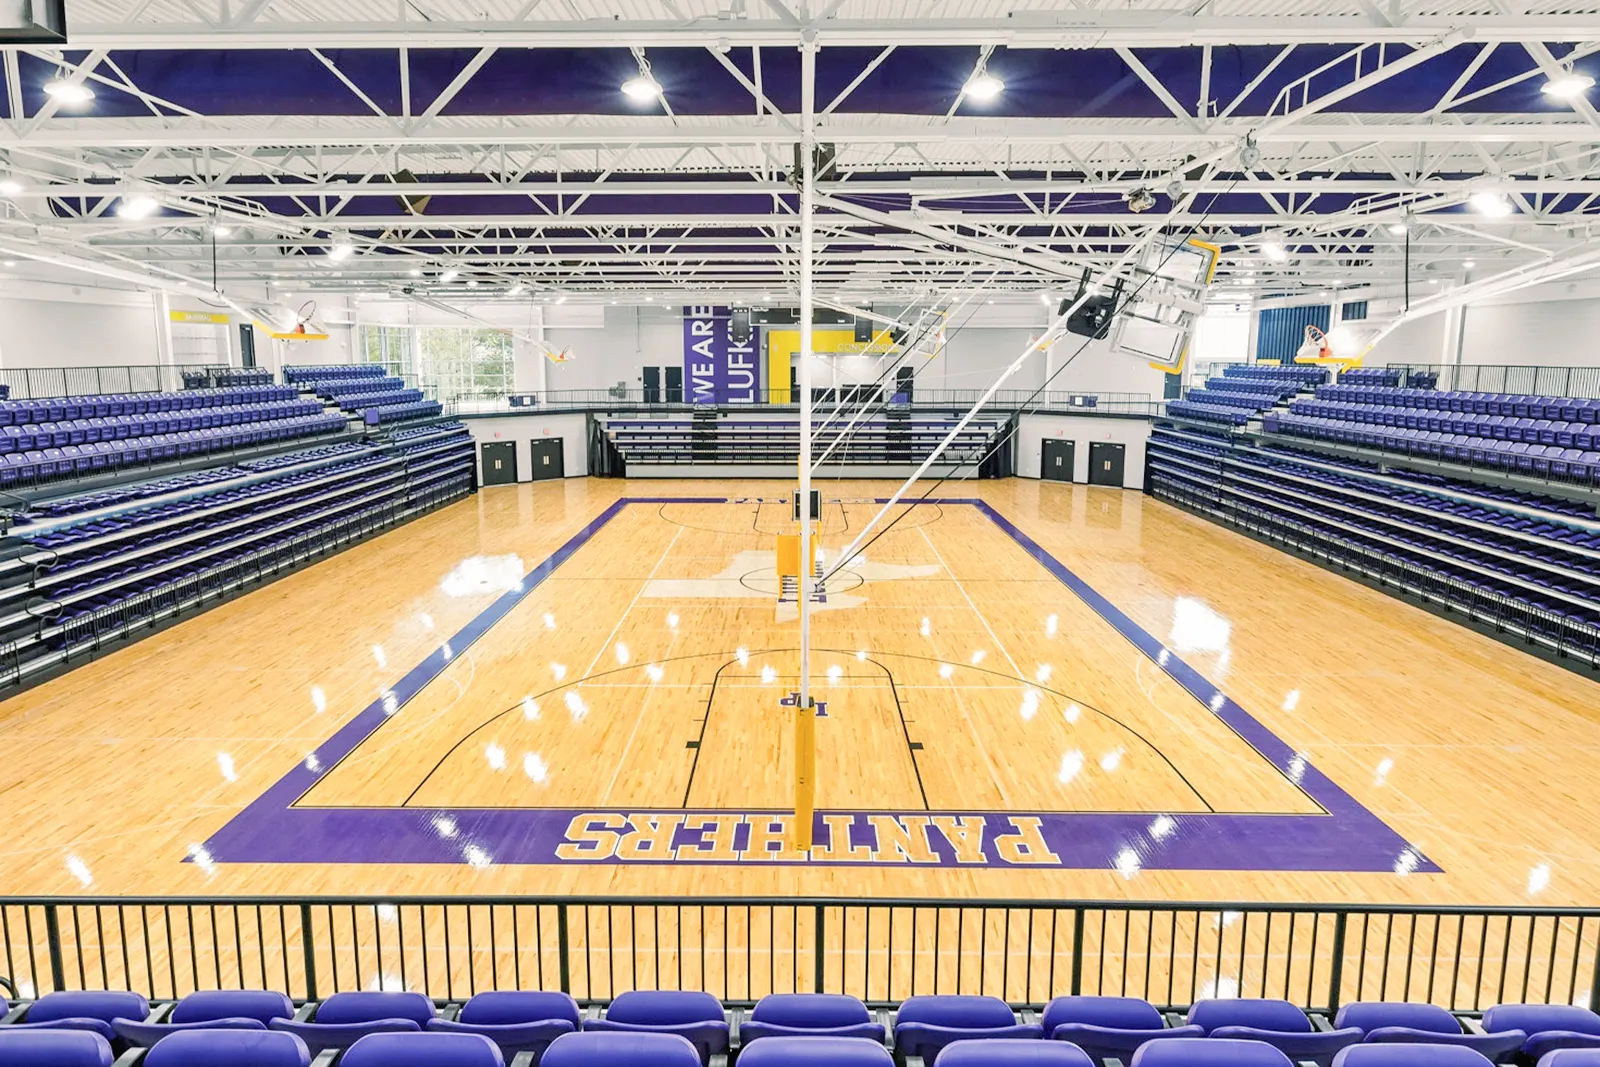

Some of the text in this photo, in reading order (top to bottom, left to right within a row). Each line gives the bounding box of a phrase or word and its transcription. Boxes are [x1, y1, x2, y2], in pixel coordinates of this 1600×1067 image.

[692, 306, 714, 402] WE ARE
[554, 813, 1062, 864] PANTHERS
